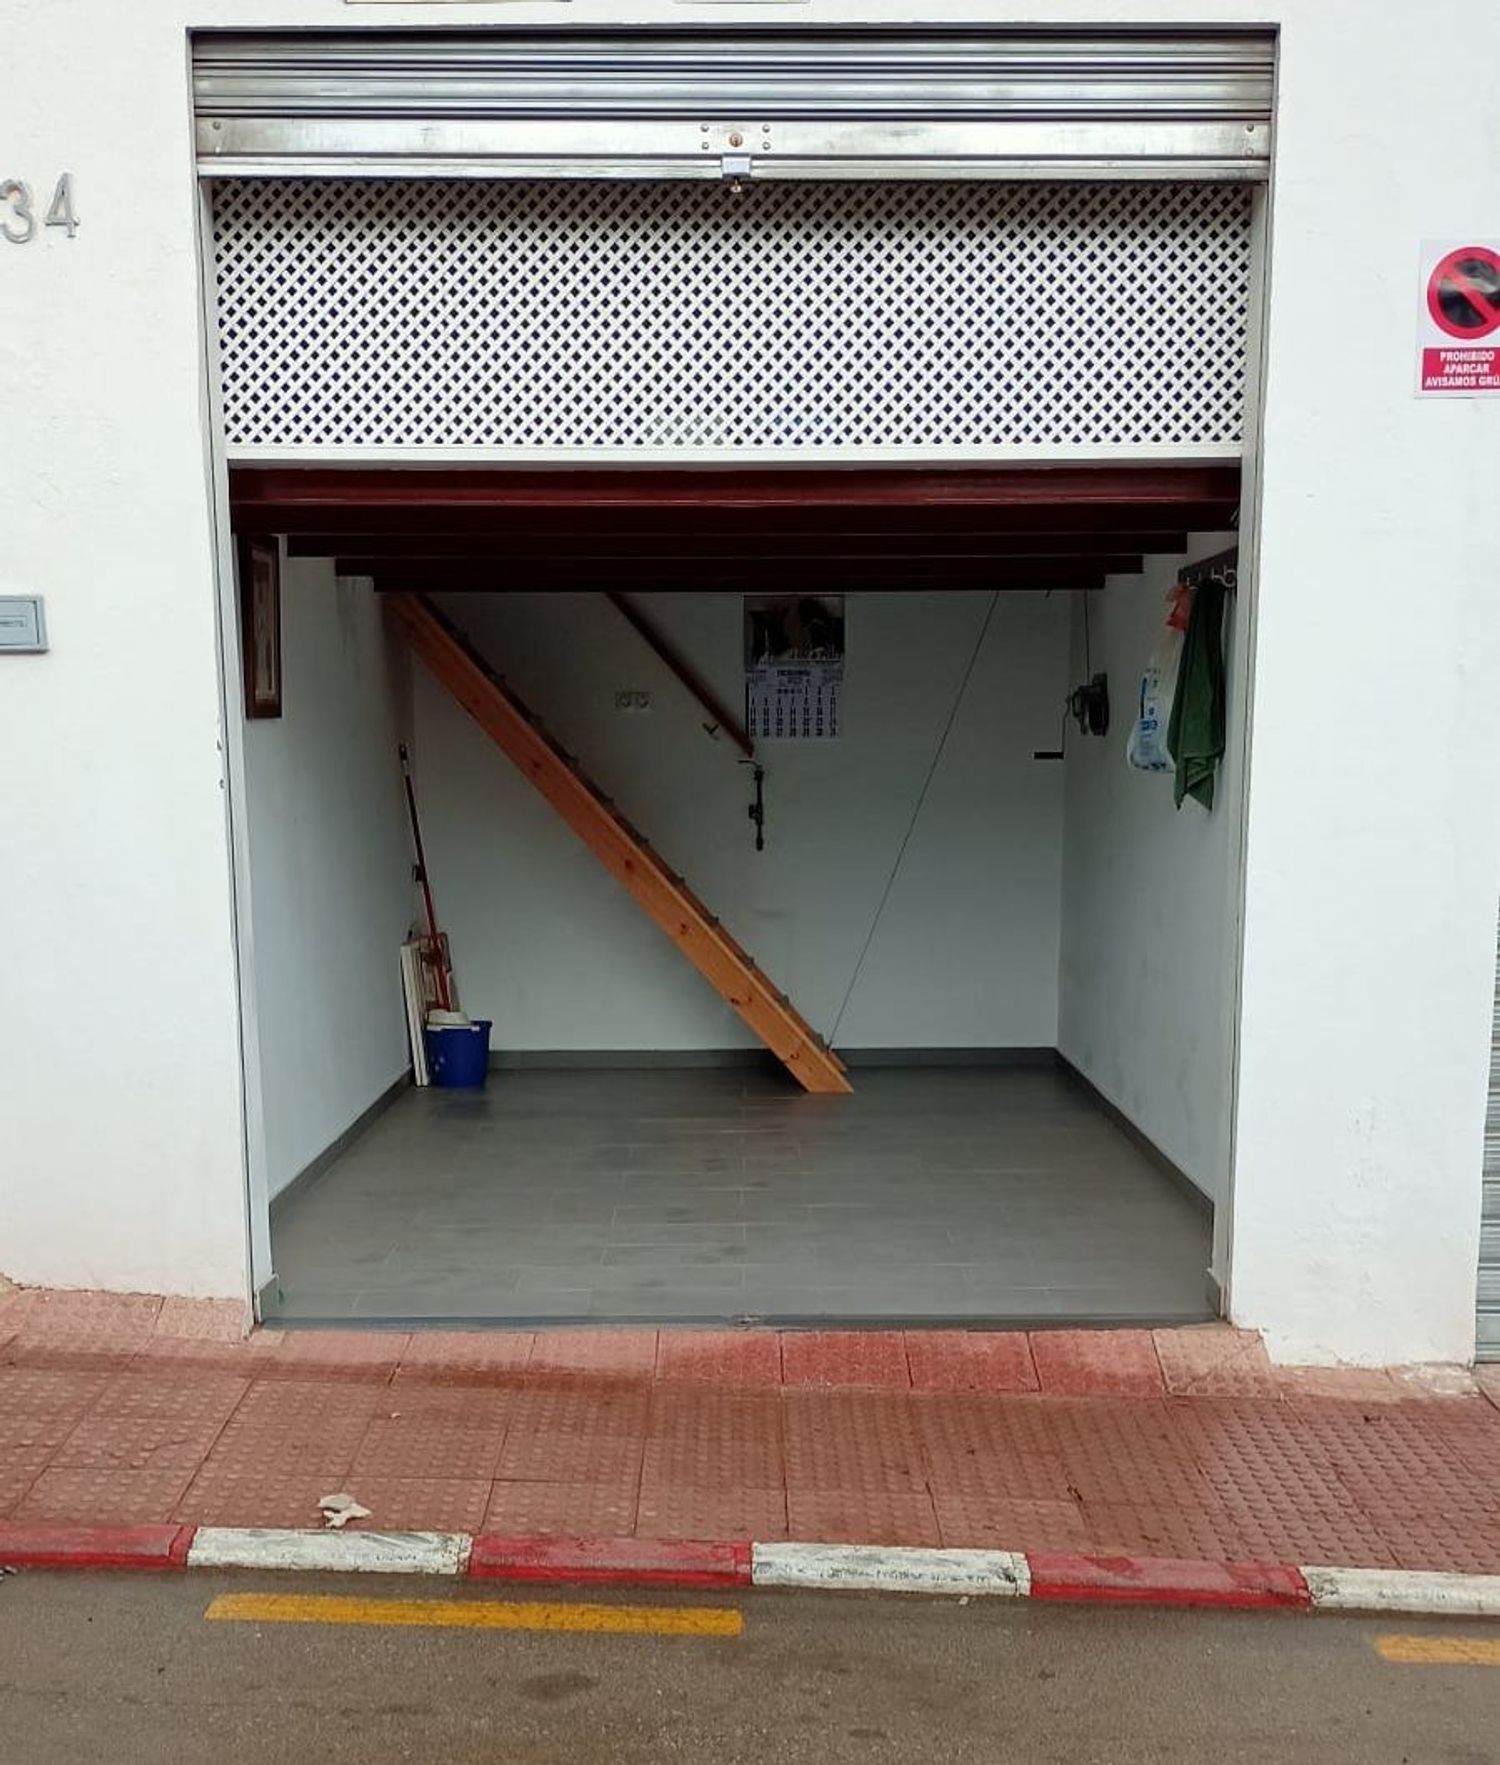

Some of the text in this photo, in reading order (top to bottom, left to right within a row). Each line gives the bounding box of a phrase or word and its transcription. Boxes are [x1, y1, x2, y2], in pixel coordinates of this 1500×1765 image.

[0, 173, 80, 244] 34
[1440, 351, 1495, 362] PROHIBIDO
[1443, 363, 1490, 374] APARCAR
[1425, 376, 1476, 387] AVISAMOS
